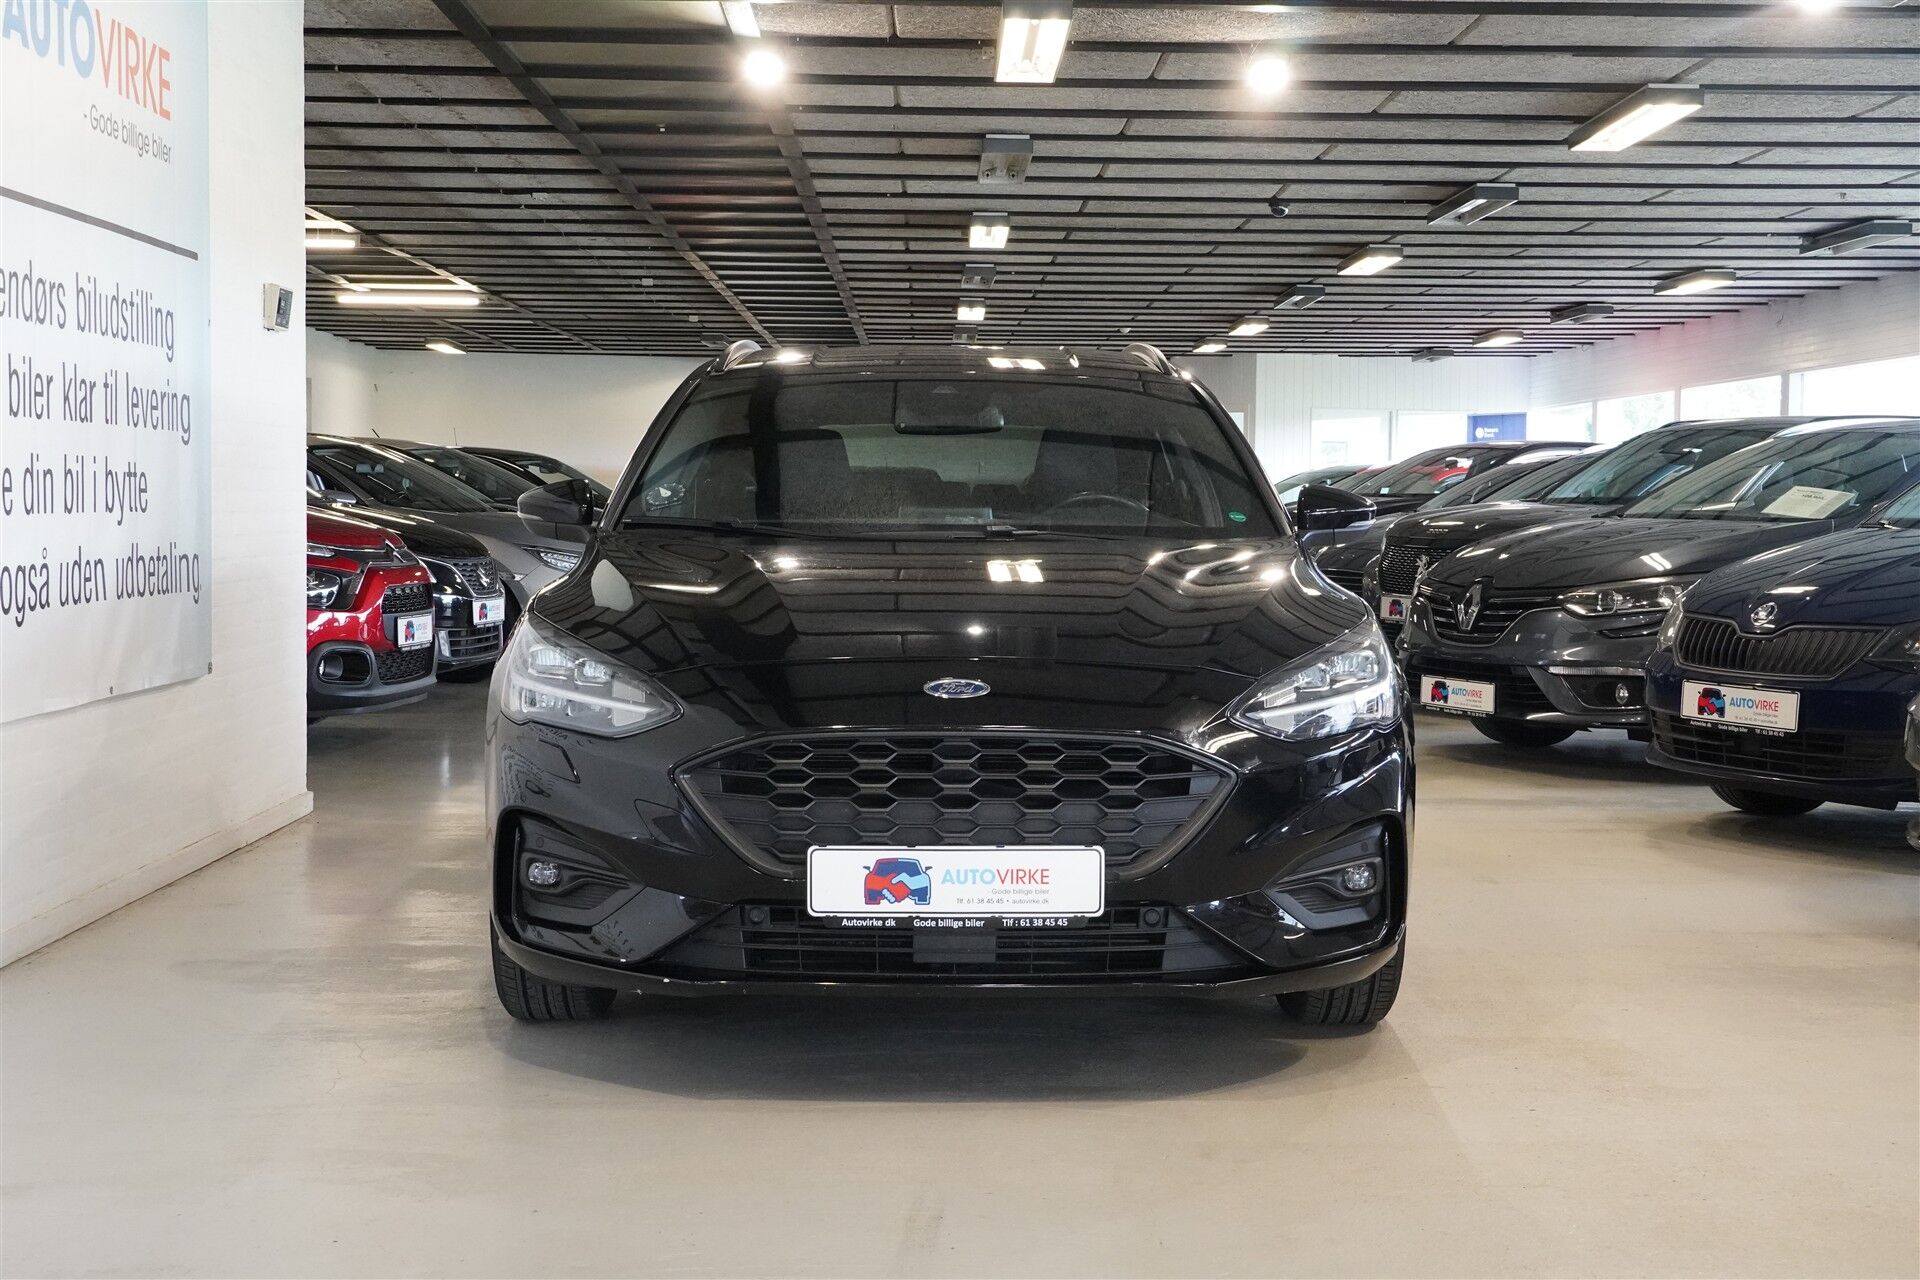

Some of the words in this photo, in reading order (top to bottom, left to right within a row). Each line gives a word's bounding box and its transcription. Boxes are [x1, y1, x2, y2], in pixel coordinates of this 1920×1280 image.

[2, 0, 171, 121] AUTOVIRKE
[90, 104, 119, 140] Gode
[121, 118, 150, 158] billige
[152, 132, 171, 164] biler
[76, 271, 175, 363] biludstilling
[8, 353, 53, 419] biler
[62, 362, 97, 424] klar
[103, 369, 118, 426] til
[126, 371, 191, 445] levering
[23, 452, 54, 515] din
[64, 454, 85, 514] bil
[93, 455, 97, 513] i
[105, 456, 148, 526] bytte
[0, 547, 50, 627] også
[60, 545, 107, 607] uden
[939, 681, 975, 693] Ford
[1451, 687, 1483, 699] AUTOVIRKE
[1729, 697, 1779, 712] AUTOVIRKE
[941, 868, 1050, 885] AUTOVIRKE
[1013, 888, 1033, 896] billige
[841, 918, 883, 926] Autovirke
[913, 918, 936, 927] Gode
[938, 918, 963, 928] billige
[965, 918, 985, 927] biler
[1020, 918, 1030, 926] 61
[1032, 918, 1043, 926] 38
[1045, 918, 1055, 926] 45
[1057, 918, 1068, 926] 45
